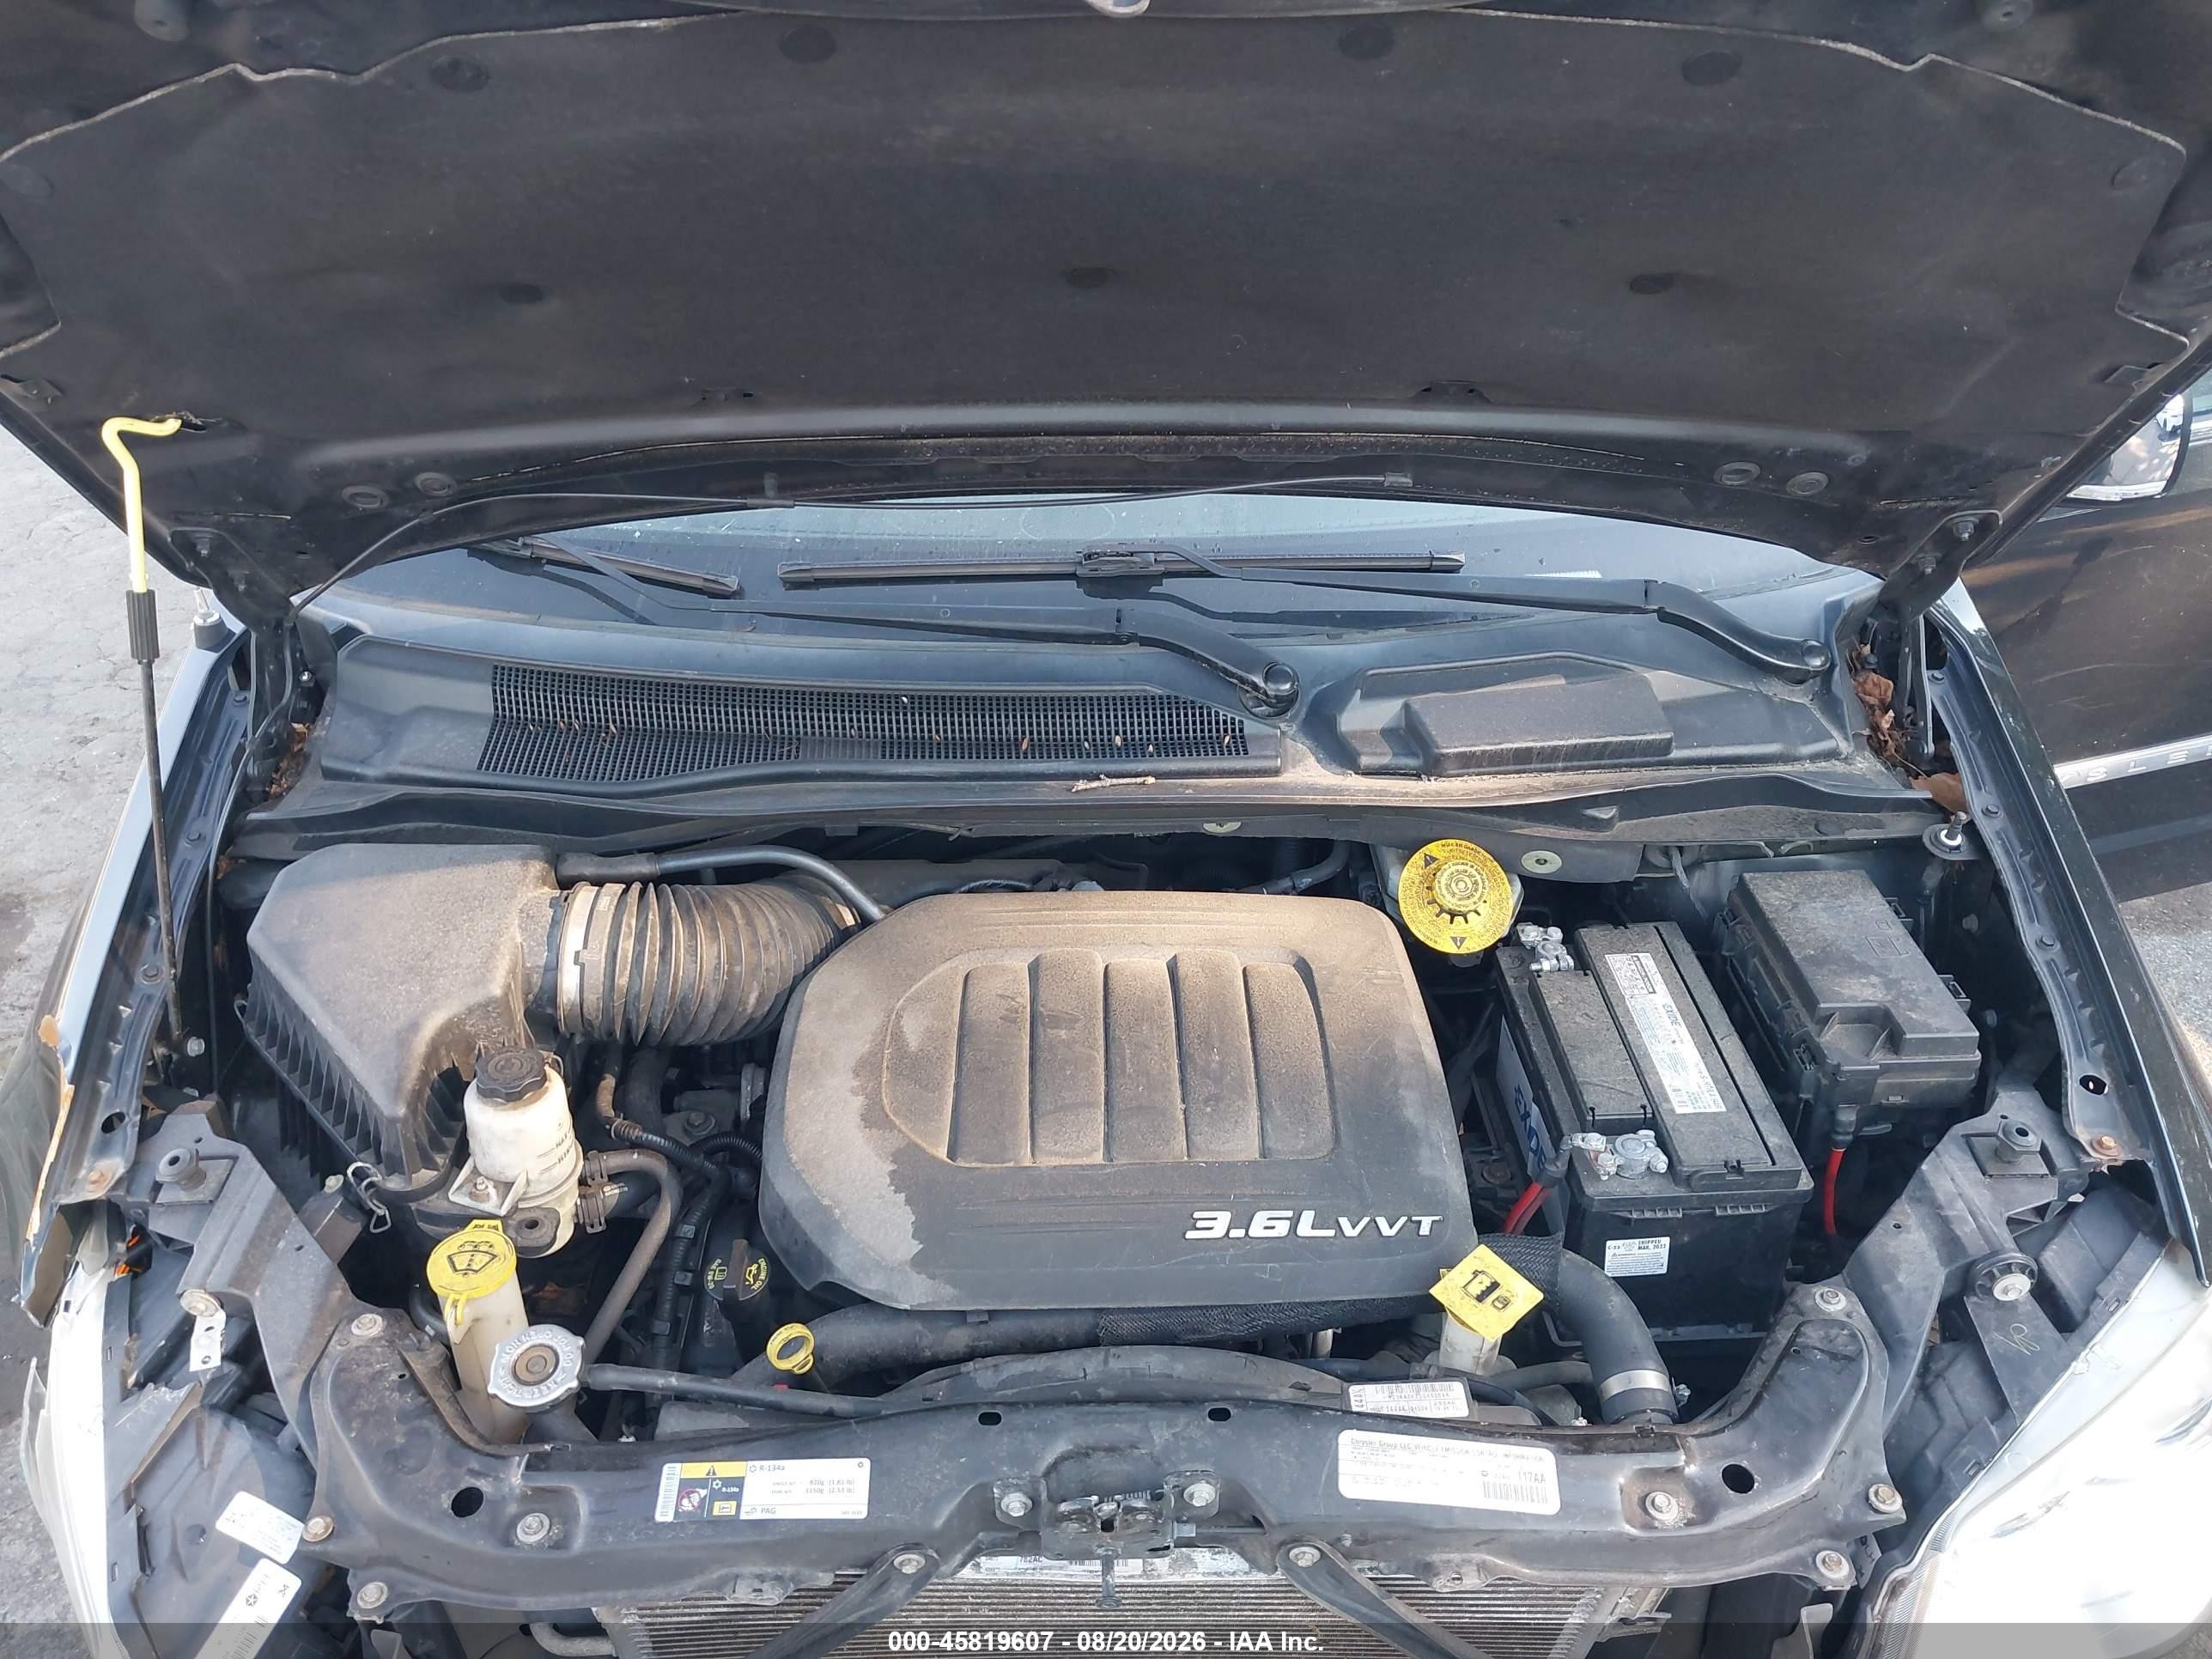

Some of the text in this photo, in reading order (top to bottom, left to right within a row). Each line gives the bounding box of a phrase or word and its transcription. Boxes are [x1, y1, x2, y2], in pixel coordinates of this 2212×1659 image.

[750, 1257, 768, 1291] ENGINE OIL
[1351, 1437, 1377, 1449] Chrysler
[1378, 1439, 1399, 1449] Group
[1400, 1442, 1413, 1450] LLC
[758, 1463, 786, 1472] R-134a
[760, 1506, 777, 1515] PAG
